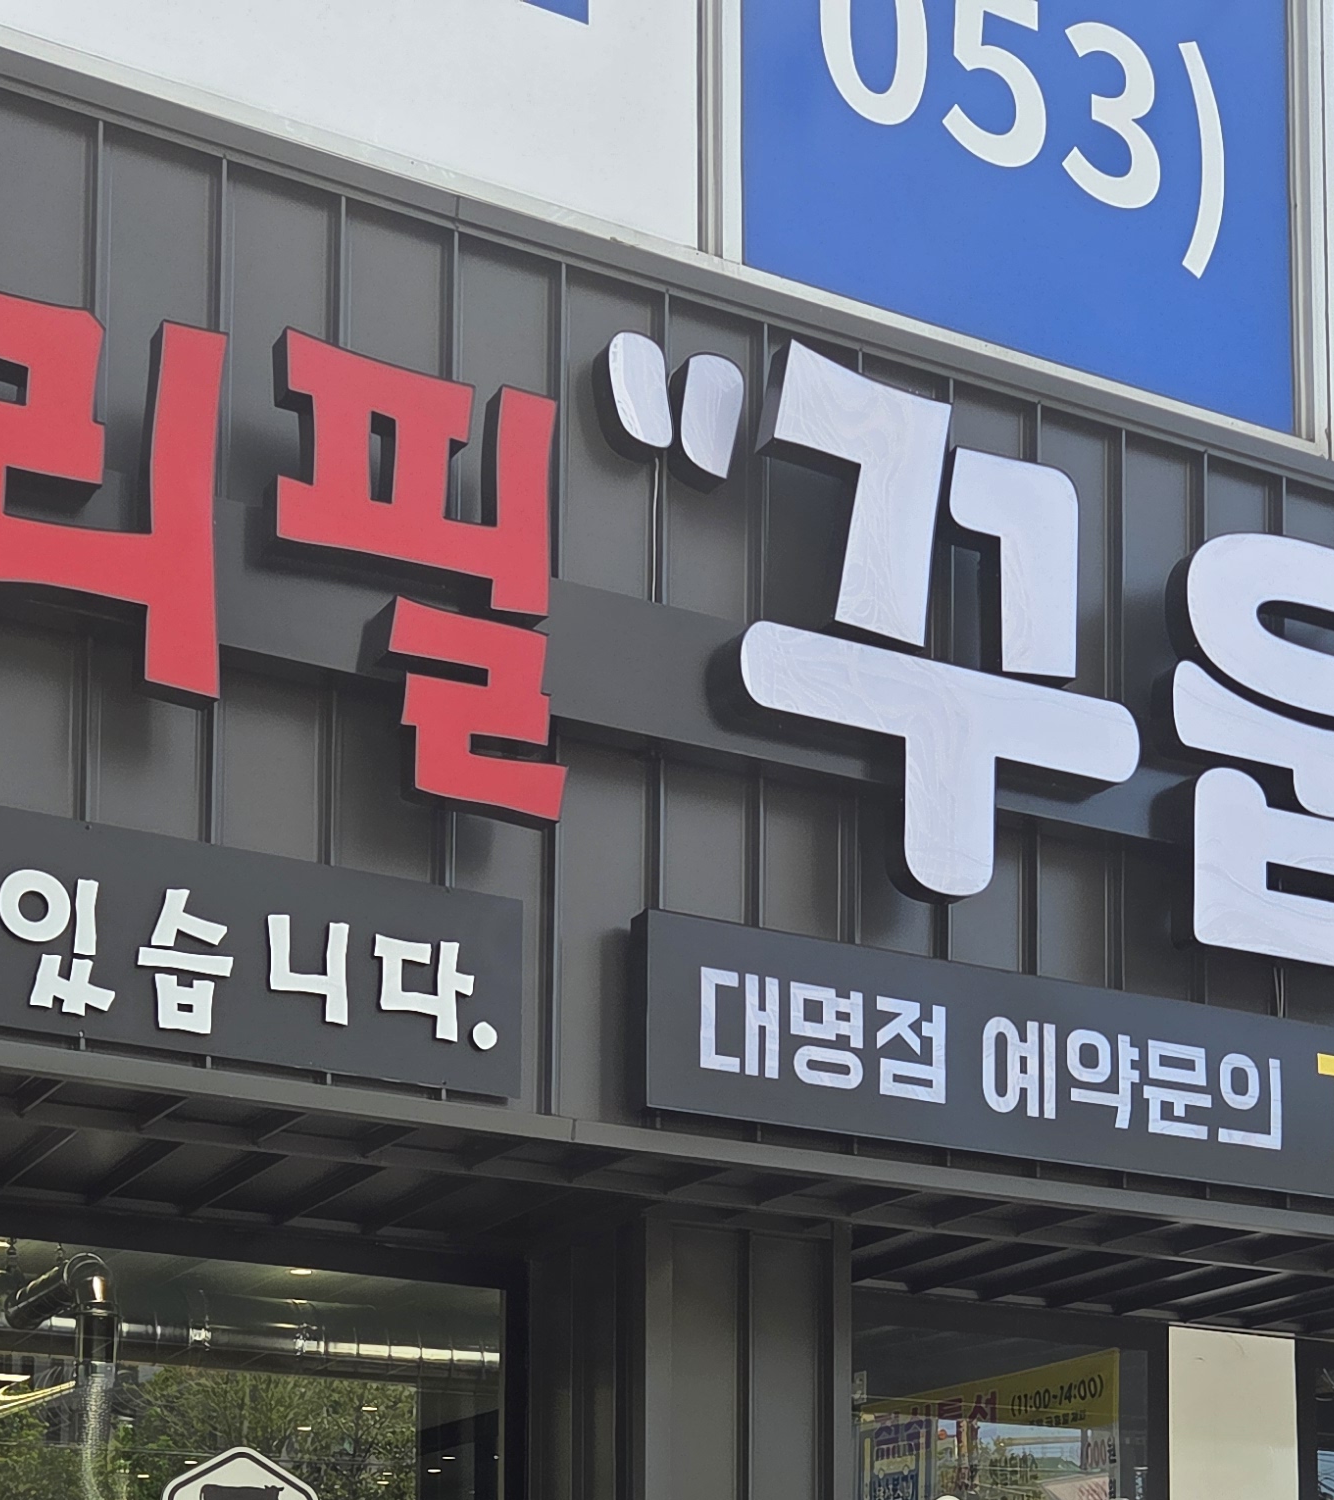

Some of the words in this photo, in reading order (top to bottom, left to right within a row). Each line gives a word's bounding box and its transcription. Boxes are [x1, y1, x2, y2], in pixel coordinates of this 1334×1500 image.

[820, 0, 1225, 278] 053)
[698, 966, 948, 1106] 대명점
[981, 1014, 1282, 1151] 예약문의
